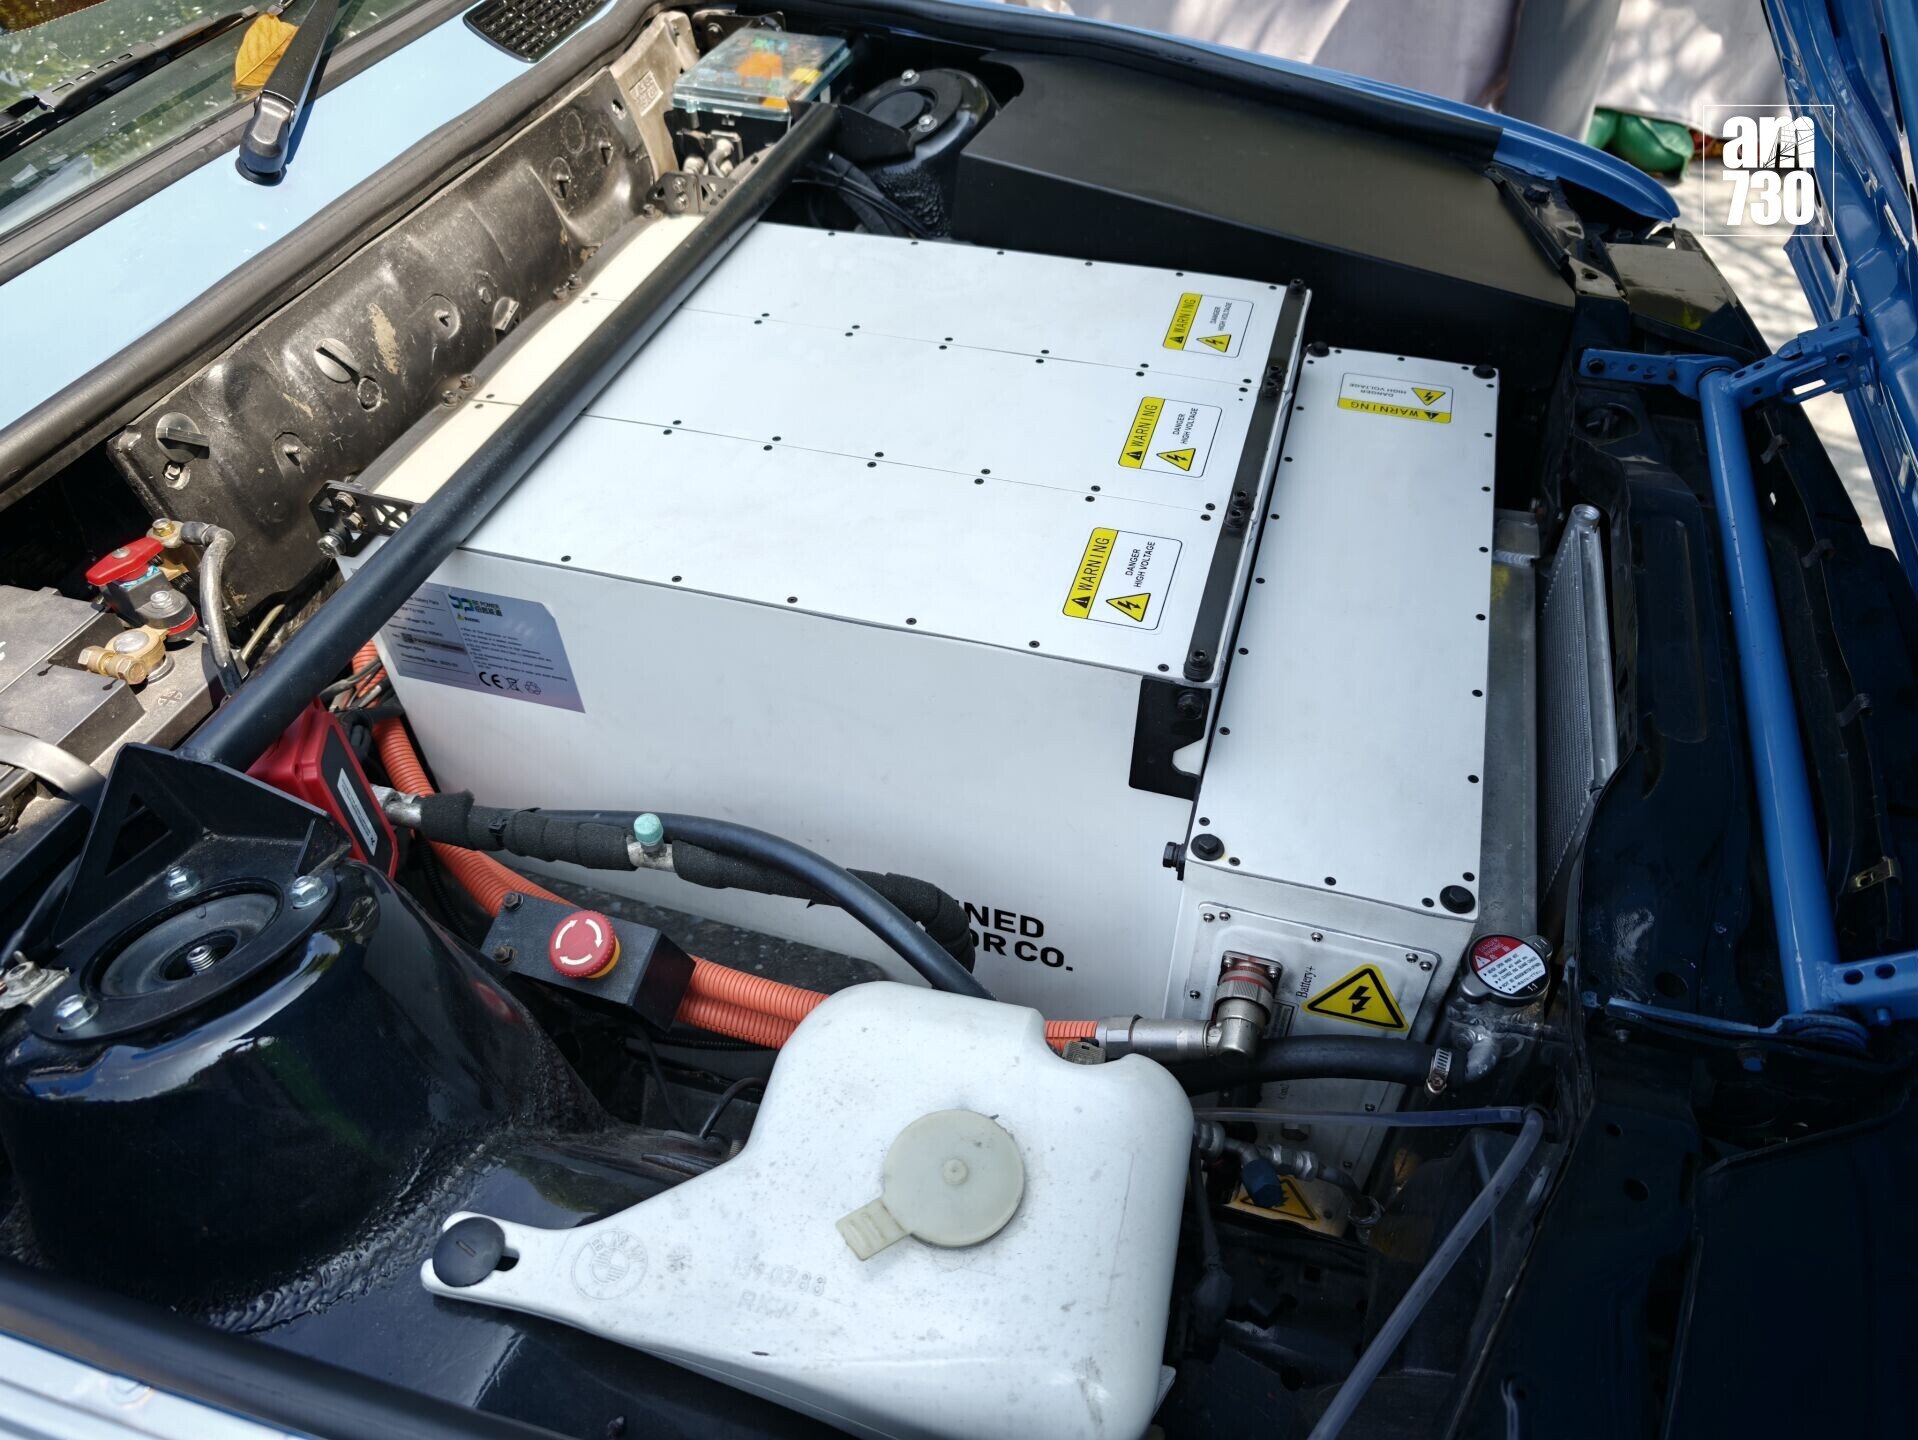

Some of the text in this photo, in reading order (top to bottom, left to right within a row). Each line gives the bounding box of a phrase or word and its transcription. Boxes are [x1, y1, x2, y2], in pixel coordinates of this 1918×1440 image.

[1173, 299, 1197, 333] WARNING
[1349, 382, 1386, 392] VOLTAGE
[1360, 389, 1394, 398] DANGER
[1130, 404, 1158, 447] WARNING
[1173, 413, 1185, 435] DANGER
[1350, 401, 1419, 417] WARNING
[1180, 407, 1198, 445] HIGH VOLTAGE
[1077, 537, 1110, 591] WARNING
[1125, 548, 1140, 576] DANGER
[1133, 541, 1156, 588] HIGH VOLTAGE
[956, 900, 1044, 938] NED
[1014, 940, 1074, 972] CO.
[1296, 966, 1316, 999] Battery+
